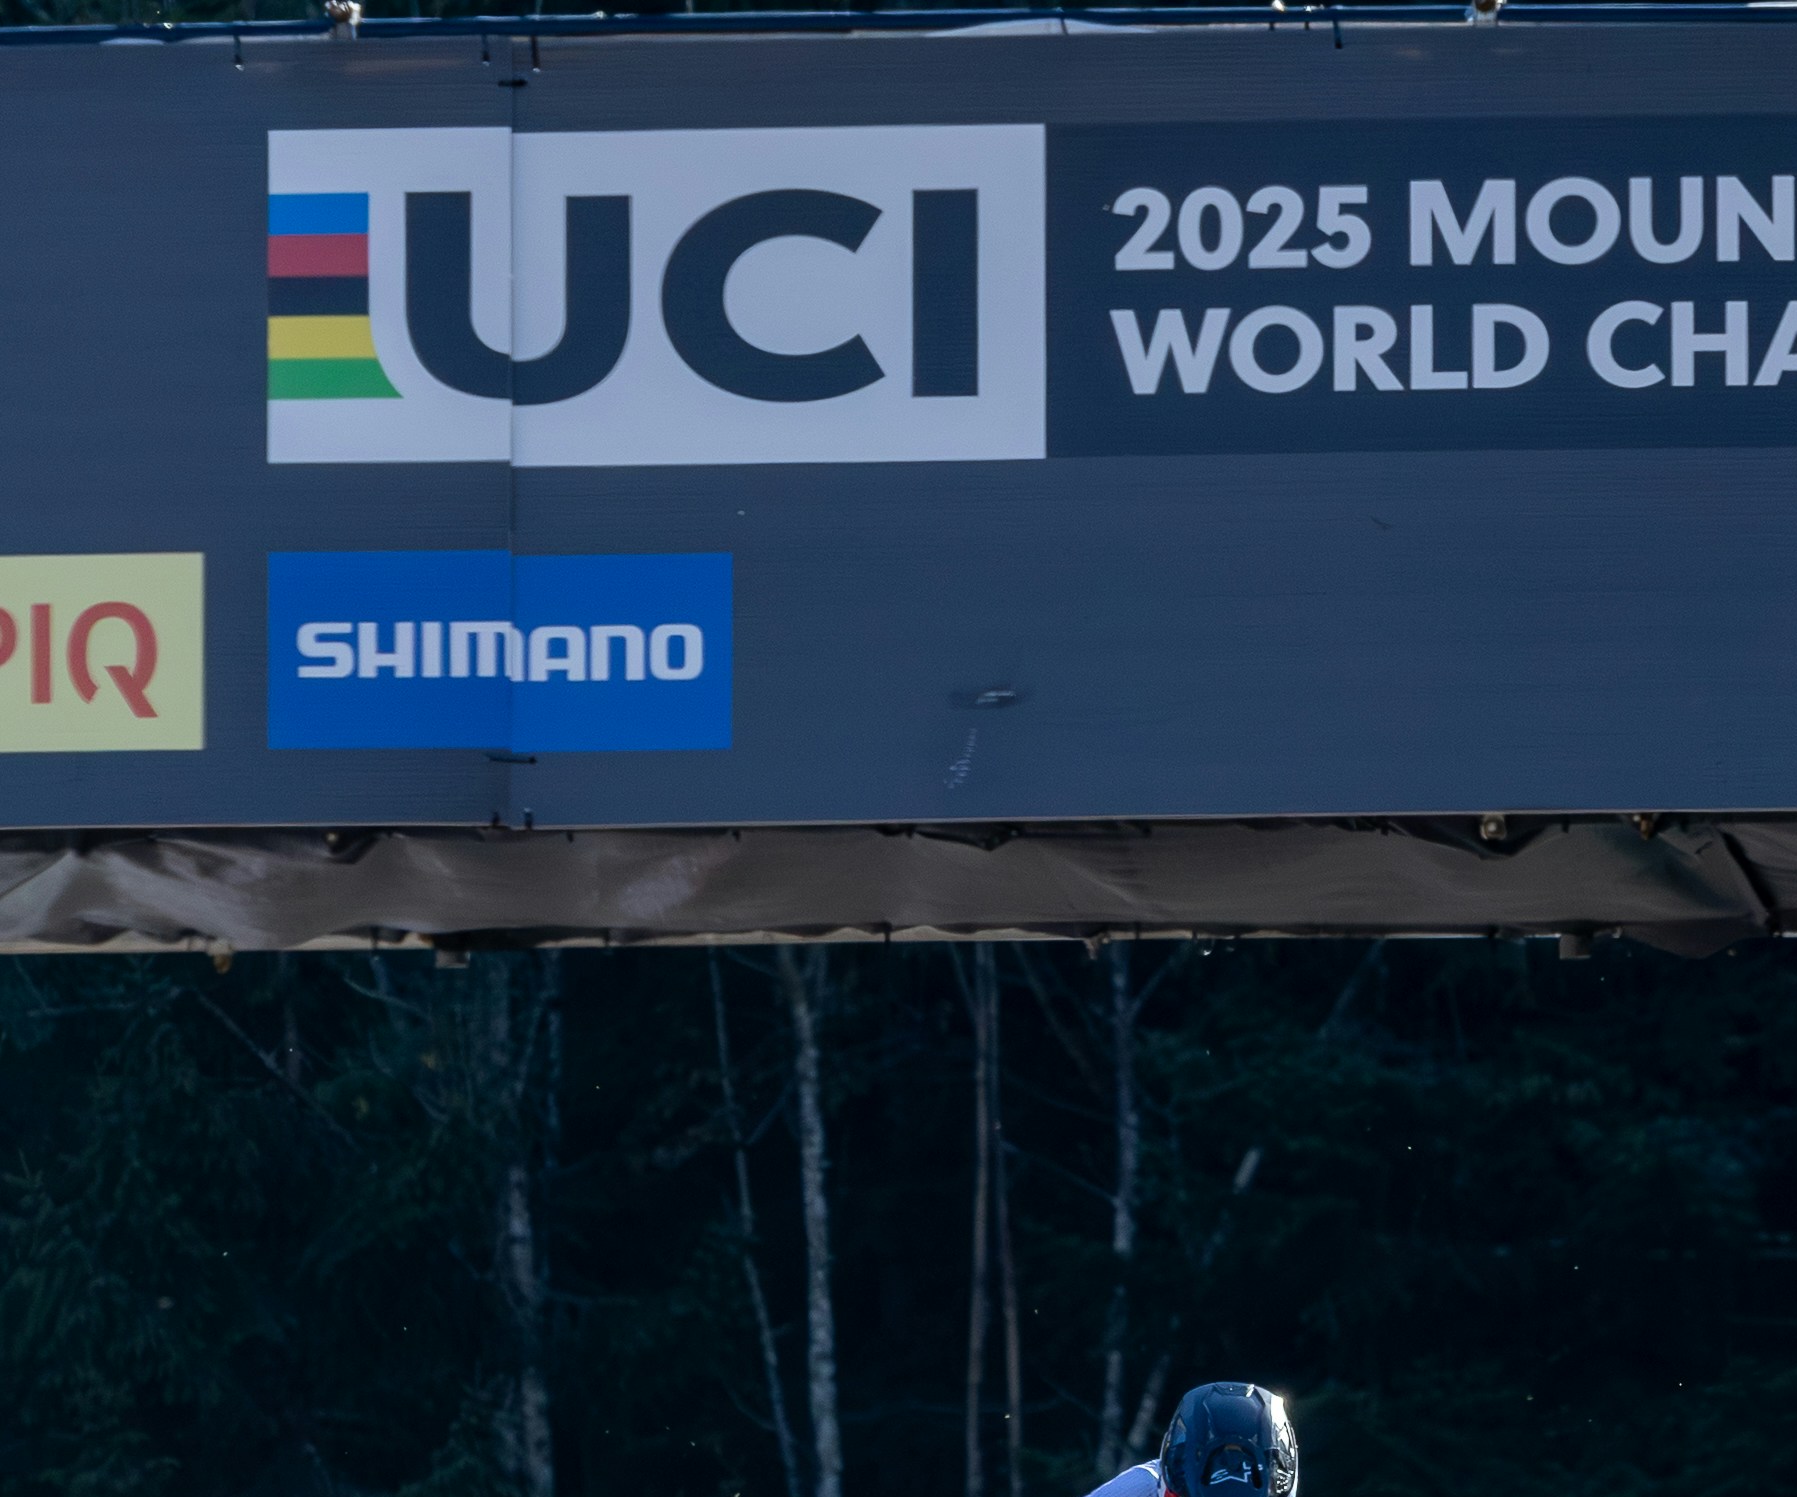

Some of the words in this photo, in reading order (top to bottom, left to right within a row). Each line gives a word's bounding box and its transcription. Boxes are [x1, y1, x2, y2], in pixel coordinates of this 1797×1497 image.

[1110, 185, 1372, 271] 2025
[405, 188, 979, 405] UCI
[1109, 303, 1550, 395] WORLD
[296, 620, 704, 682] SHIMANO
